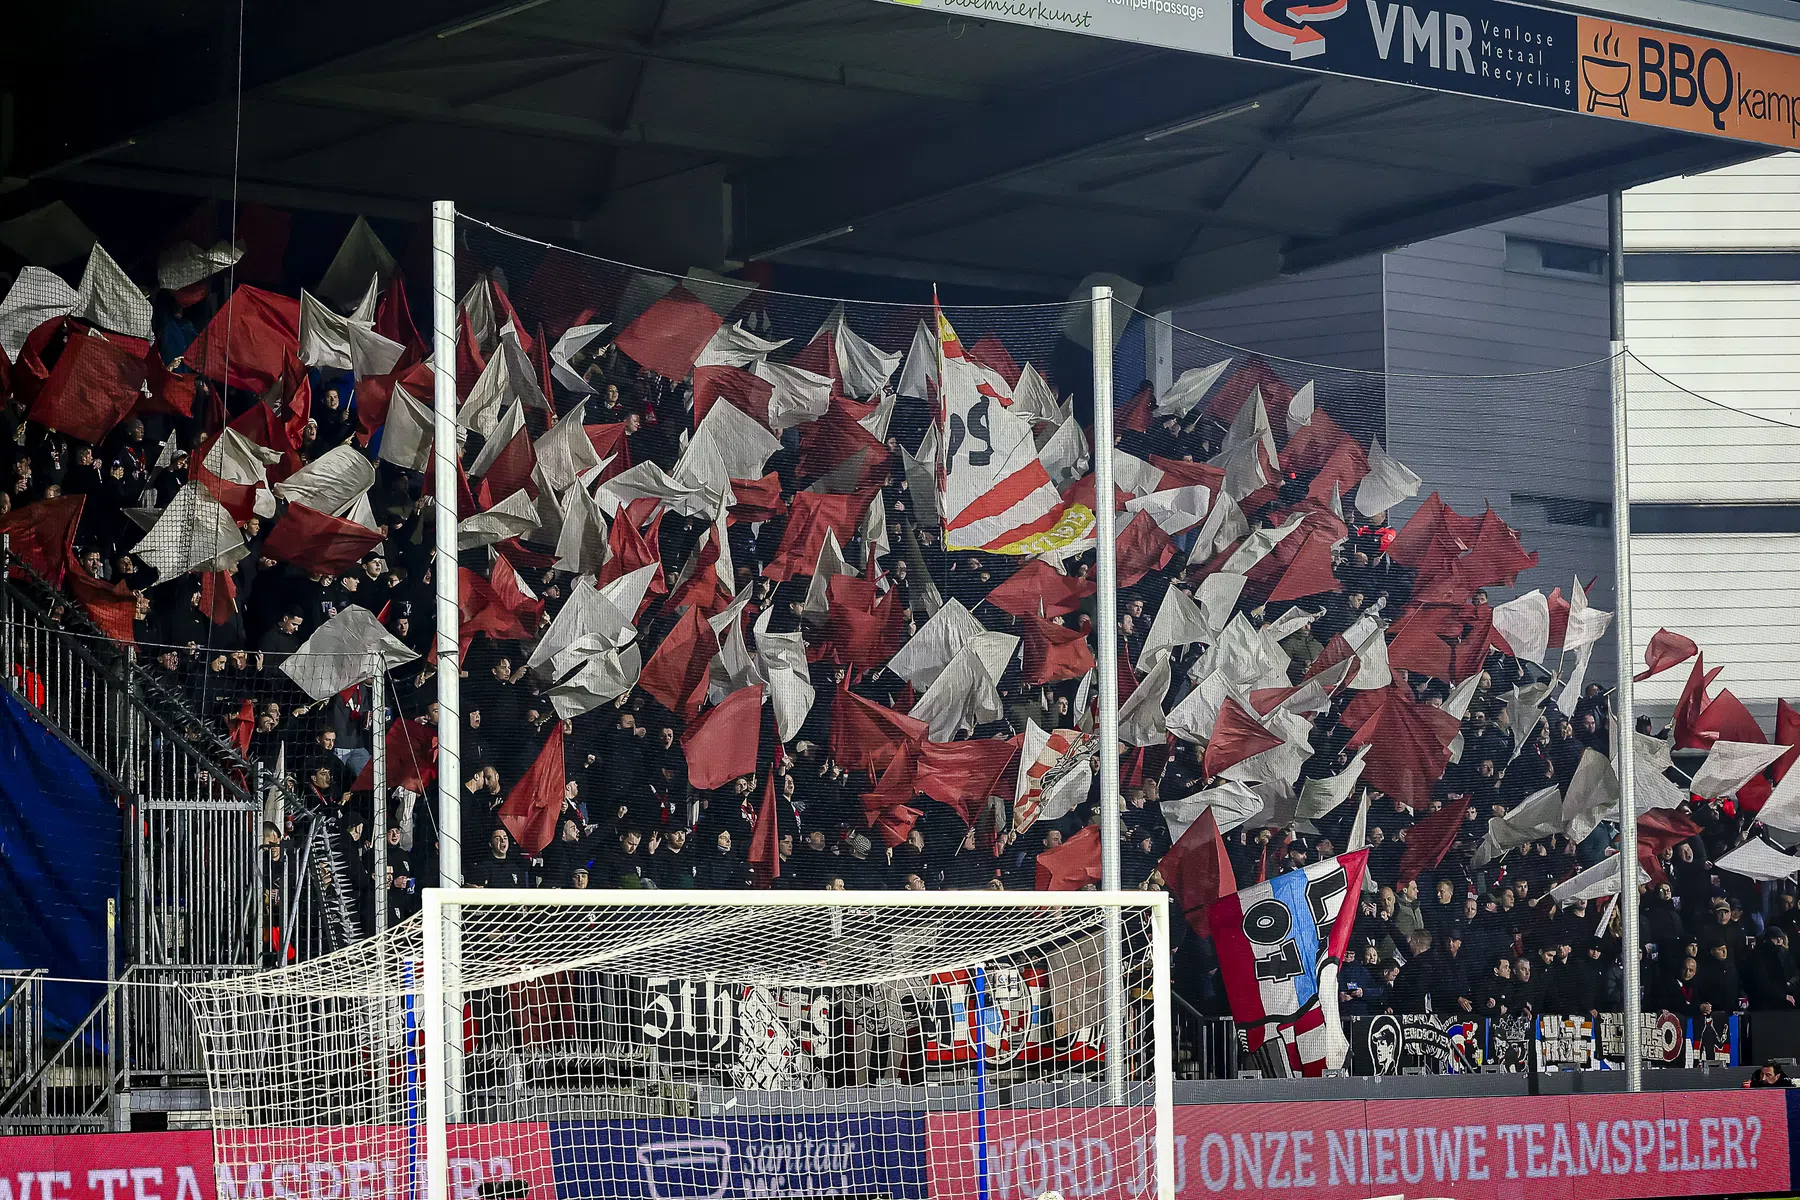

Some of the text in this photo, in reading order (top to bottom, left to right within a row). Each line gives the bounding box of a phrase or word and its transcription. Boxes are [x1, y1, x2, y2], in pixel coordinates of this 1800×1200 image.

[944, 0, 1093, 28] oemsierkunst
[1365, 0, 1476, 75] VMR
[1480, 19, 1554, 47] Venlose
[1480, 41, 1543, 66] Metaal
[1480, 61, 1571, 95] Recycling
[1201, 1130, 1318, 1190] ONZE
[1325, 1125, 1491, 1186] NIEUWE
[1496, 1115, 1762, 1179] TEAMSPELER?
